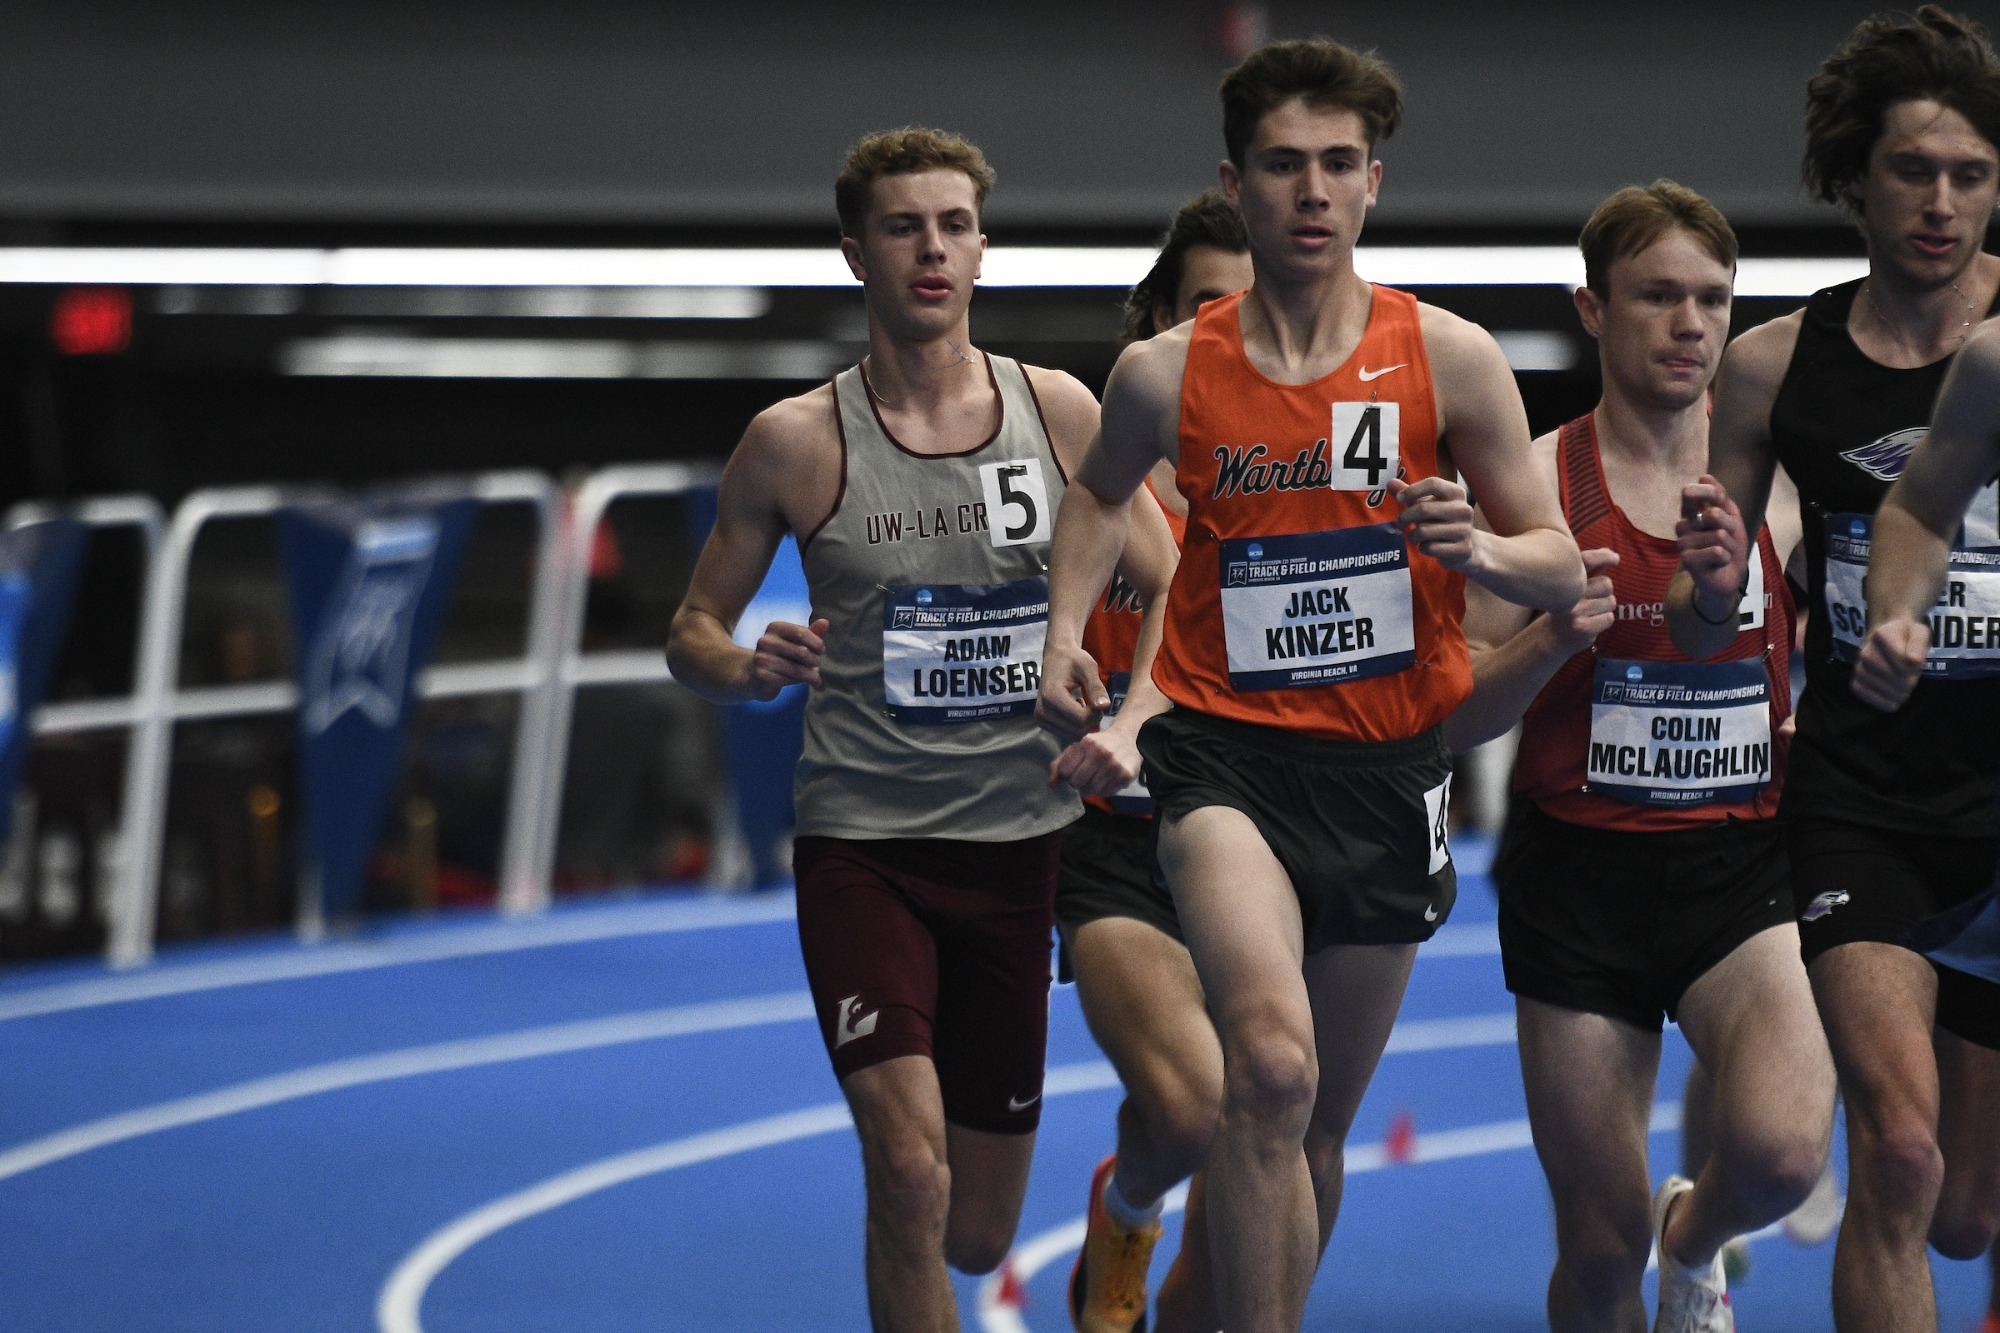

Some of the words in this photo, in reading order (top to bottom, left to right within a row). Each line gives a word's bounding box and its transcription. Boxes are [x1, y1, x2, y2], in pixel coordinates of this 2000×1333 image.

[1343, 408, 1388, 485] 4
[996, 465, 1038, 541] 5
[865, 507, 950, 546] UW-LA
[957, 501, 990, 534] CR
[1249, 566, 1280, 578] TRACK
[1280, 564, 1289, 576] &
[1289, 561, 1317, 575] FIELD
[1319, 549, 1401, 572] CHAMPIONSHIPS
[1849, 543, 1871, 557] TRAC
[915, 612, 947, 623] TRACK
[947, 612, 955, 623] &
[956, 611, 981, 623] FIELD
[982, 602, 1048, 621] CHAMPIONSHI
[1285, 586, 1352, 619] JACK
[944, 635, 1011, 662] ADAM
[1265, 617, 1375, 661] KINZER
[913, 660, 1041, 698] LOENSER
[1291, 670, 1322, 681] VIRGINIA
[1349, 664, 1358, 673] VA
[1625, 688, 1656, 700] TRACK
[1656, 690, 1665, 700] &
[1666, 690, 1691, 701] FIELD
[1694, 684, 1766, 701] CHAMPIONSHIPS
[948, 709, 977, 718] VIRGINIA
[1651, 716, 1722, 742] COLIN
[1590, 742, 1769, 779] MCLAUGHLIN
[1650, 791, 1681, 800] VIRGINIA
